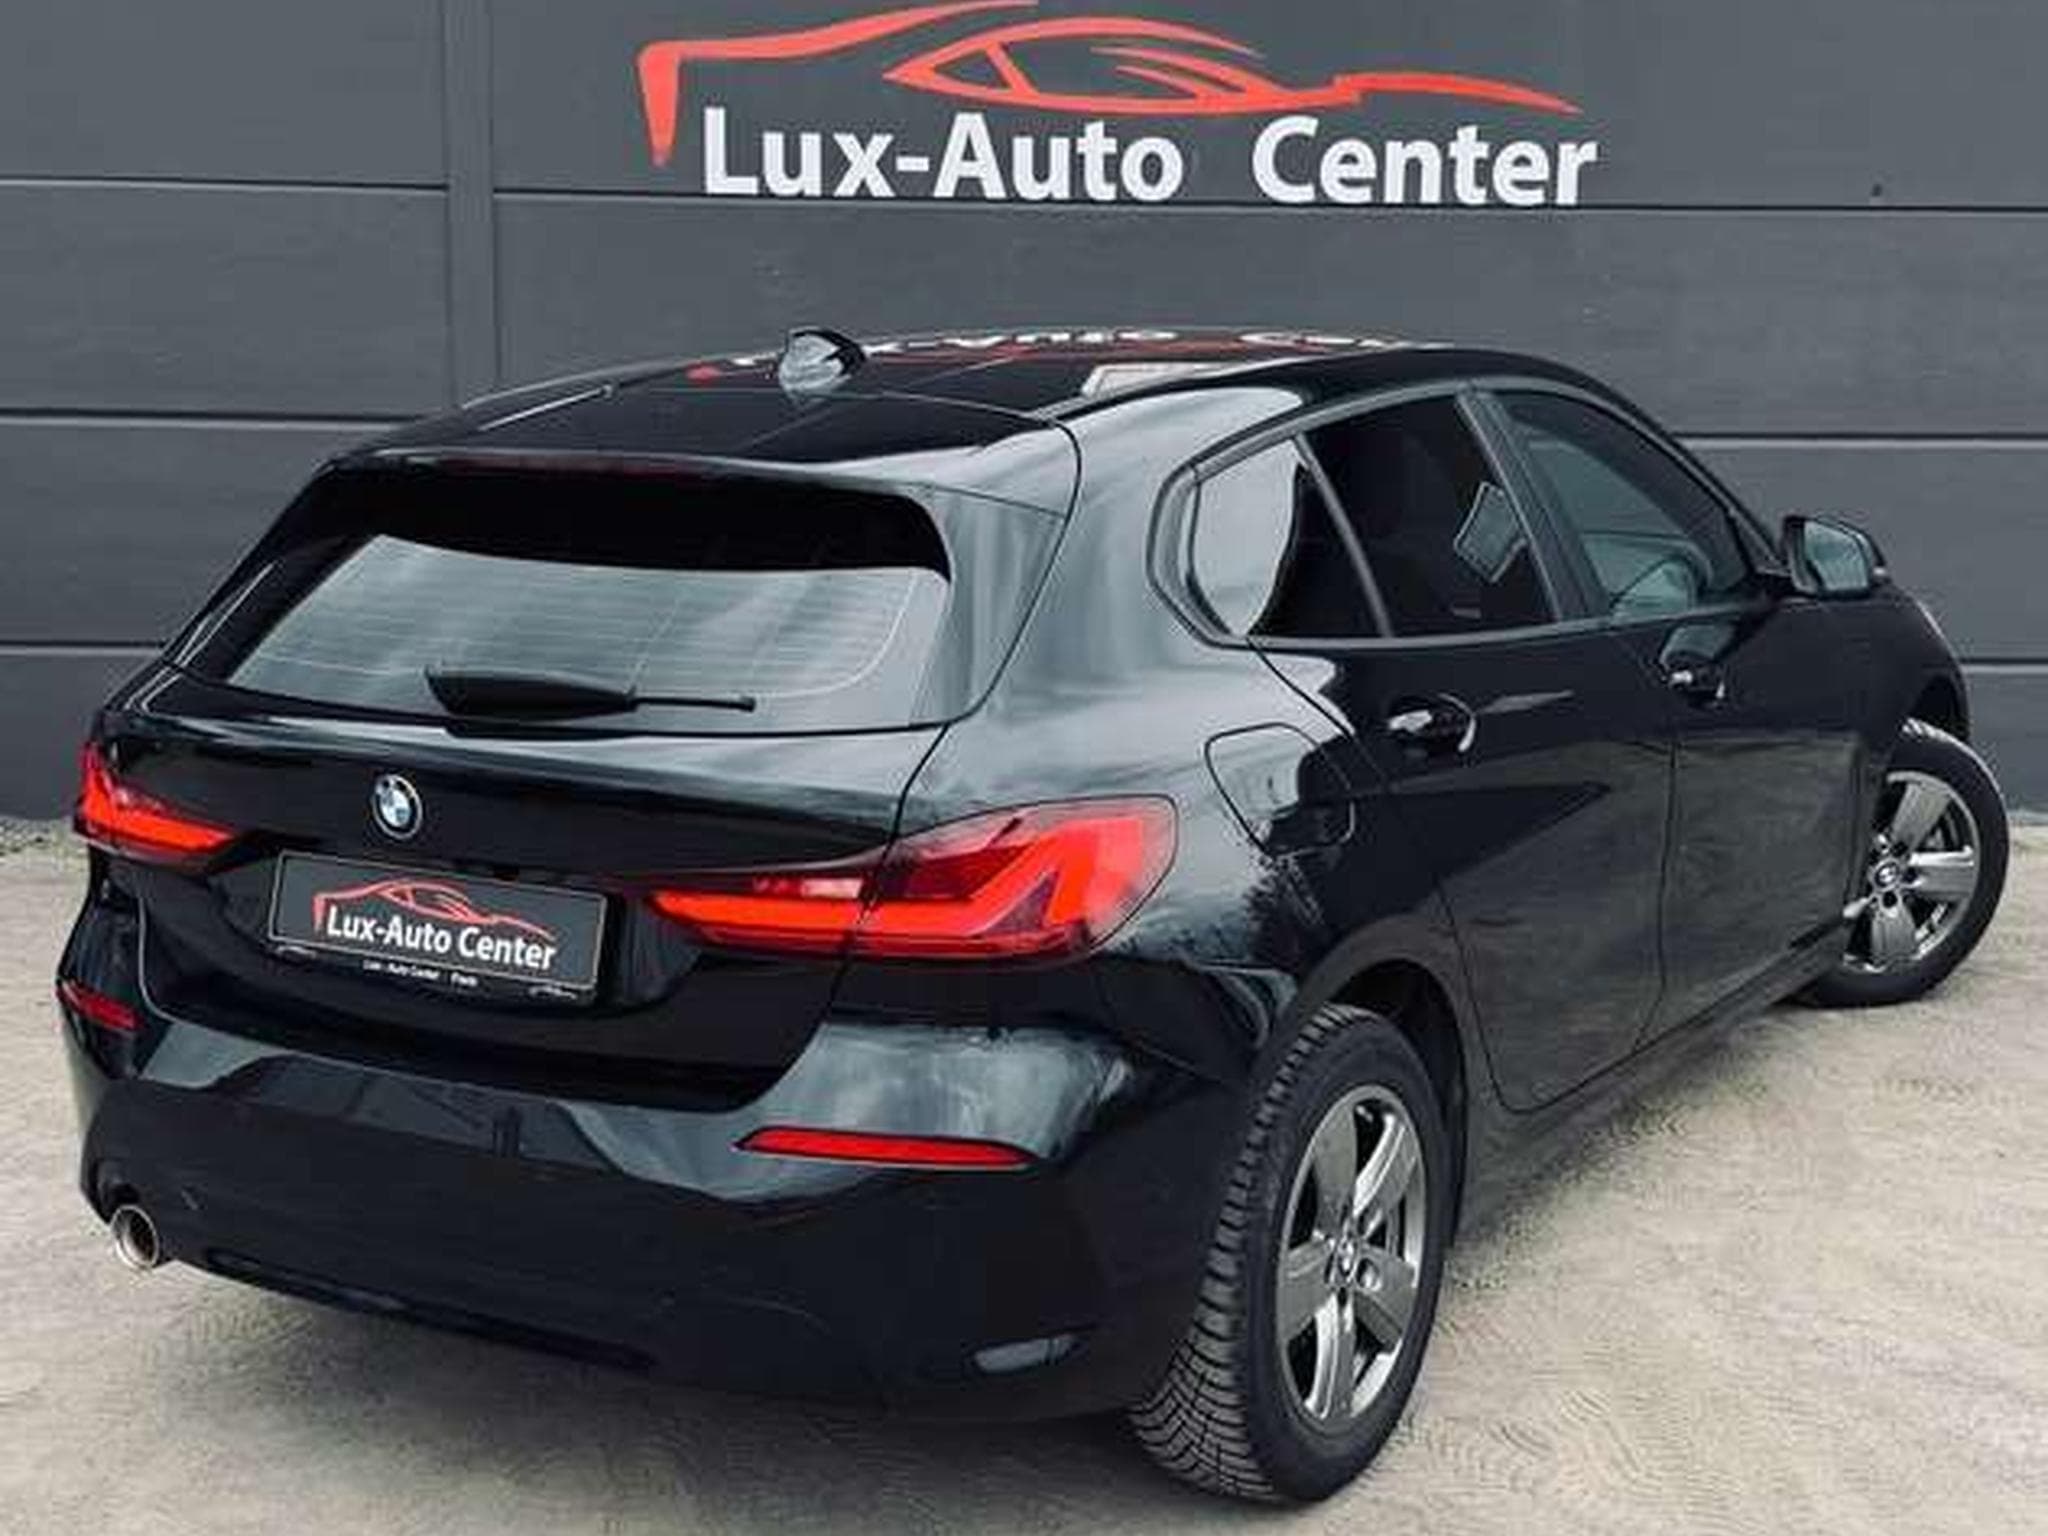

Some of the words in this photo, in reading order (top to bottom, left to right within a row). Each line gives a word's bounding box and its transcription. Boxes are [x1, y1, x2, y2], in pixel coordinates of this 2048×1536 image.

[703, 107, 1184, 202] Lux-Auto
[1251, 115, 1598, 207] Center
[327, 905, 451, 953] Lux-Auto
[458, 926, 557, 970] Center
